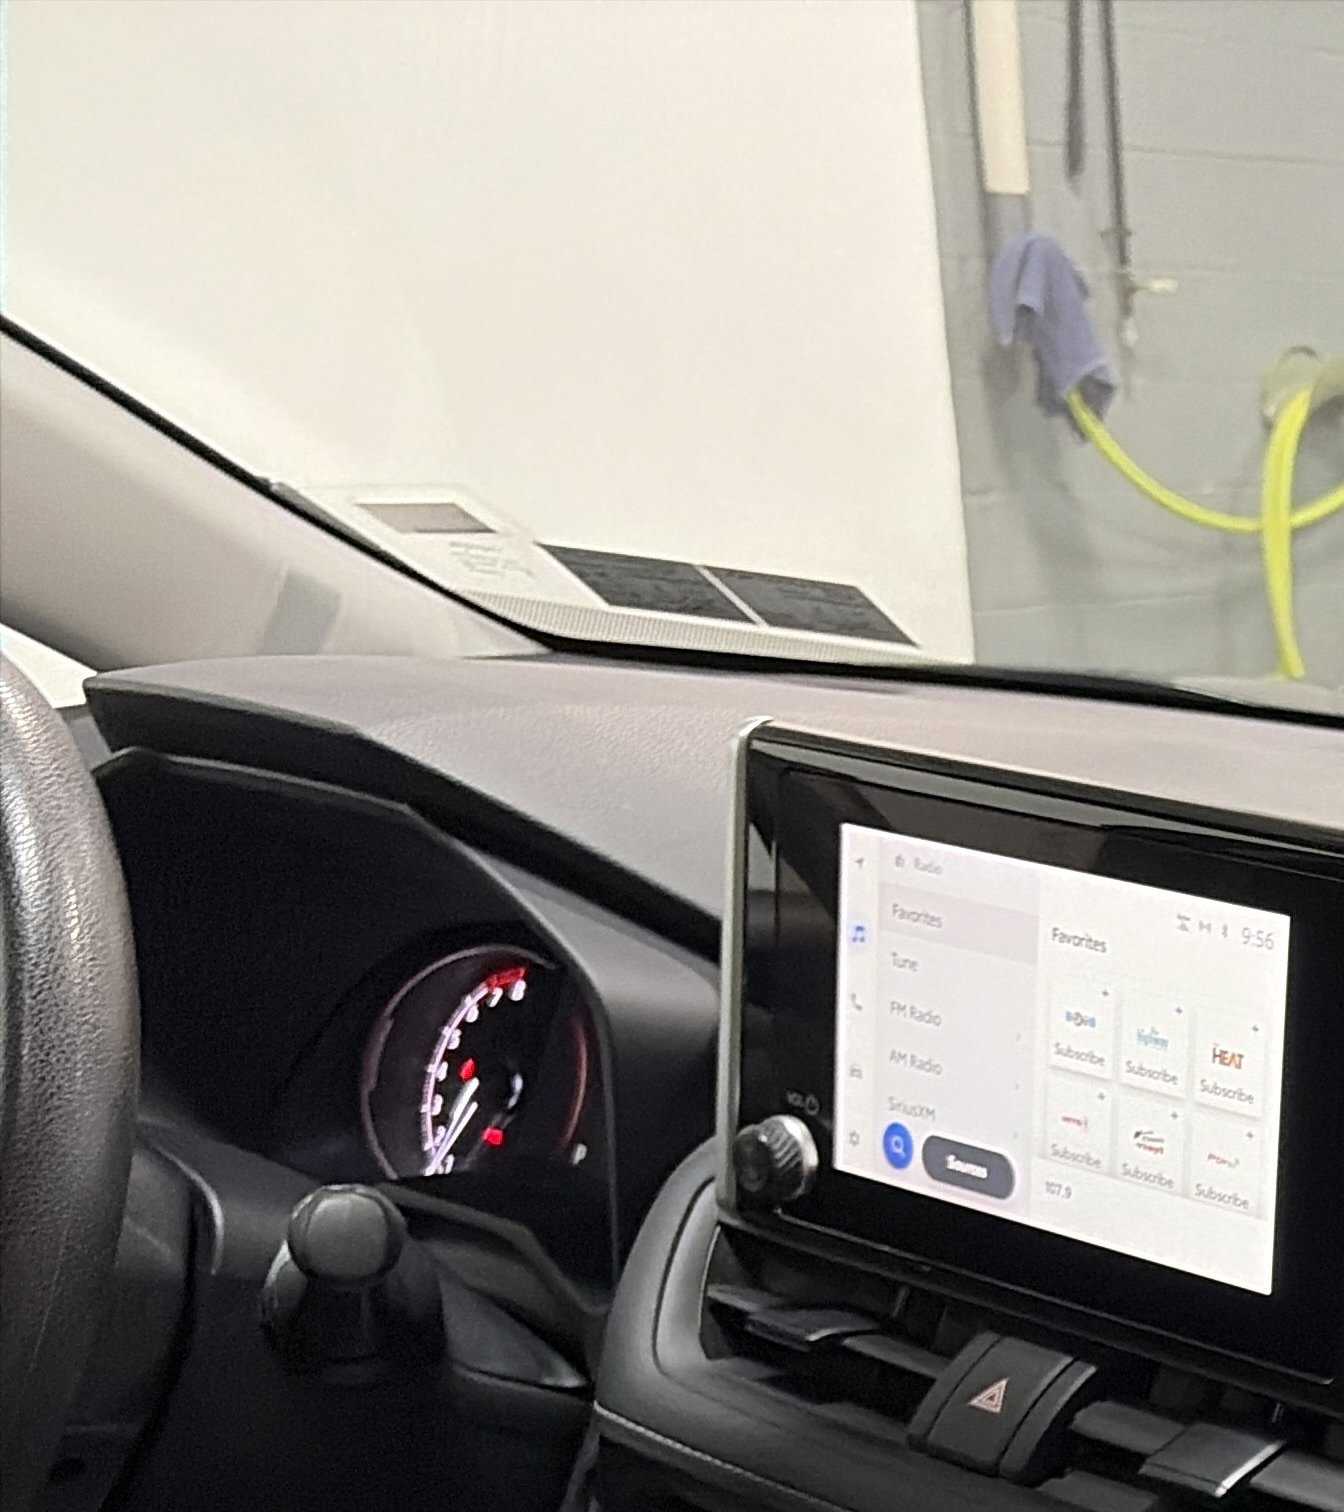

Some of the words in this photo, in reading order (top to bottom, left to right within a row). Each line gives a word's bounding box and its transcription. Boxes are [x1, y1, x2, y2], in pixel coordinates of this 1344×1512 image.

[891, 902, 943, 929] Favorites
[1051, 926, 1107, 953] Favorites
[1241, 926, 1275, 950] 9:56
[891, 951, 919, 973] Tune
[487, 987, 504, 1008] 7
[890, 1000, 908, 1018] FM
[909, 1005, 943, 1027] Radio
[889, 1049, 908, 1066] AM
[909, 1054, 943, 1076] Radio
[1053, 1042, 1106, 1068] Subscribe
[1211, 1046, 1245, 1070] HEAT
[1125, 1060, 1179, 1086] Subscribe
[1199, 1078, 1255, 1105] Subscribe
[887, 1096, 936, 1121] SiriusXM
[1051, 1143, 1103, 1169] Subscribe
[1122, 1162, 1175, 1190] Subscribe
[1044, 1180, 1073, 1200] 107.9
[1194, 1182, 1250, 1211] Subscribe
